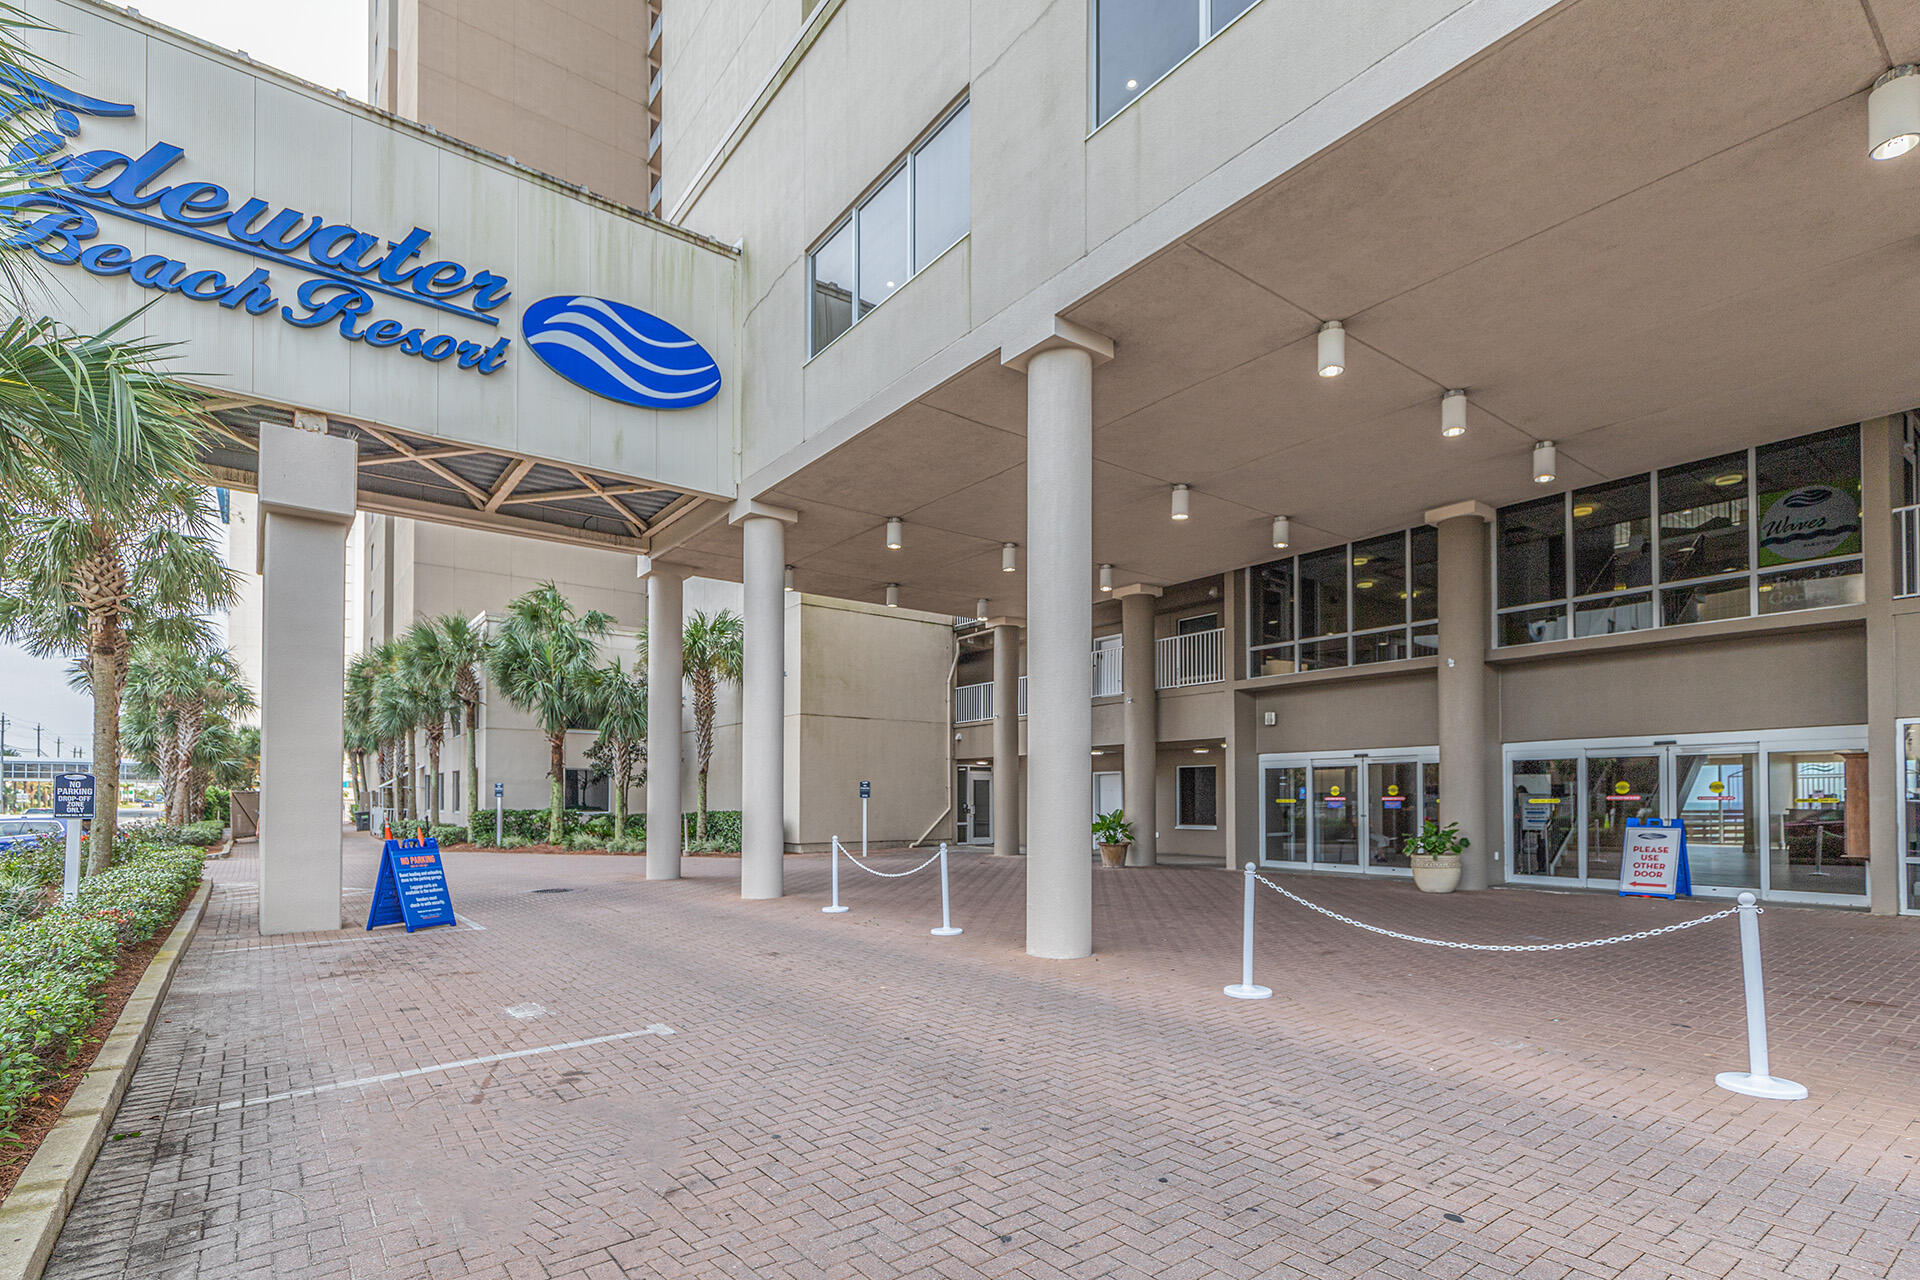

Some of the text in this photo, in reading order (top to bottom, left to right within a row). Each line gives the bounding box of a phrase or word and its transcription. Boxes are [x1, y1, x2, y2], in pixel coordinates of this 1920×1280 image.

[0, 192, 511, 376] Beach Resort
[1762, 516, 1827, 537] Waves
[1633, 845, 1669, 853] PLEASE
[400, 855, 435, 865] NO PARKING
[1633, 862, 1666, 870] OTHER
[1633, 870, 1663, 878] DOOR
